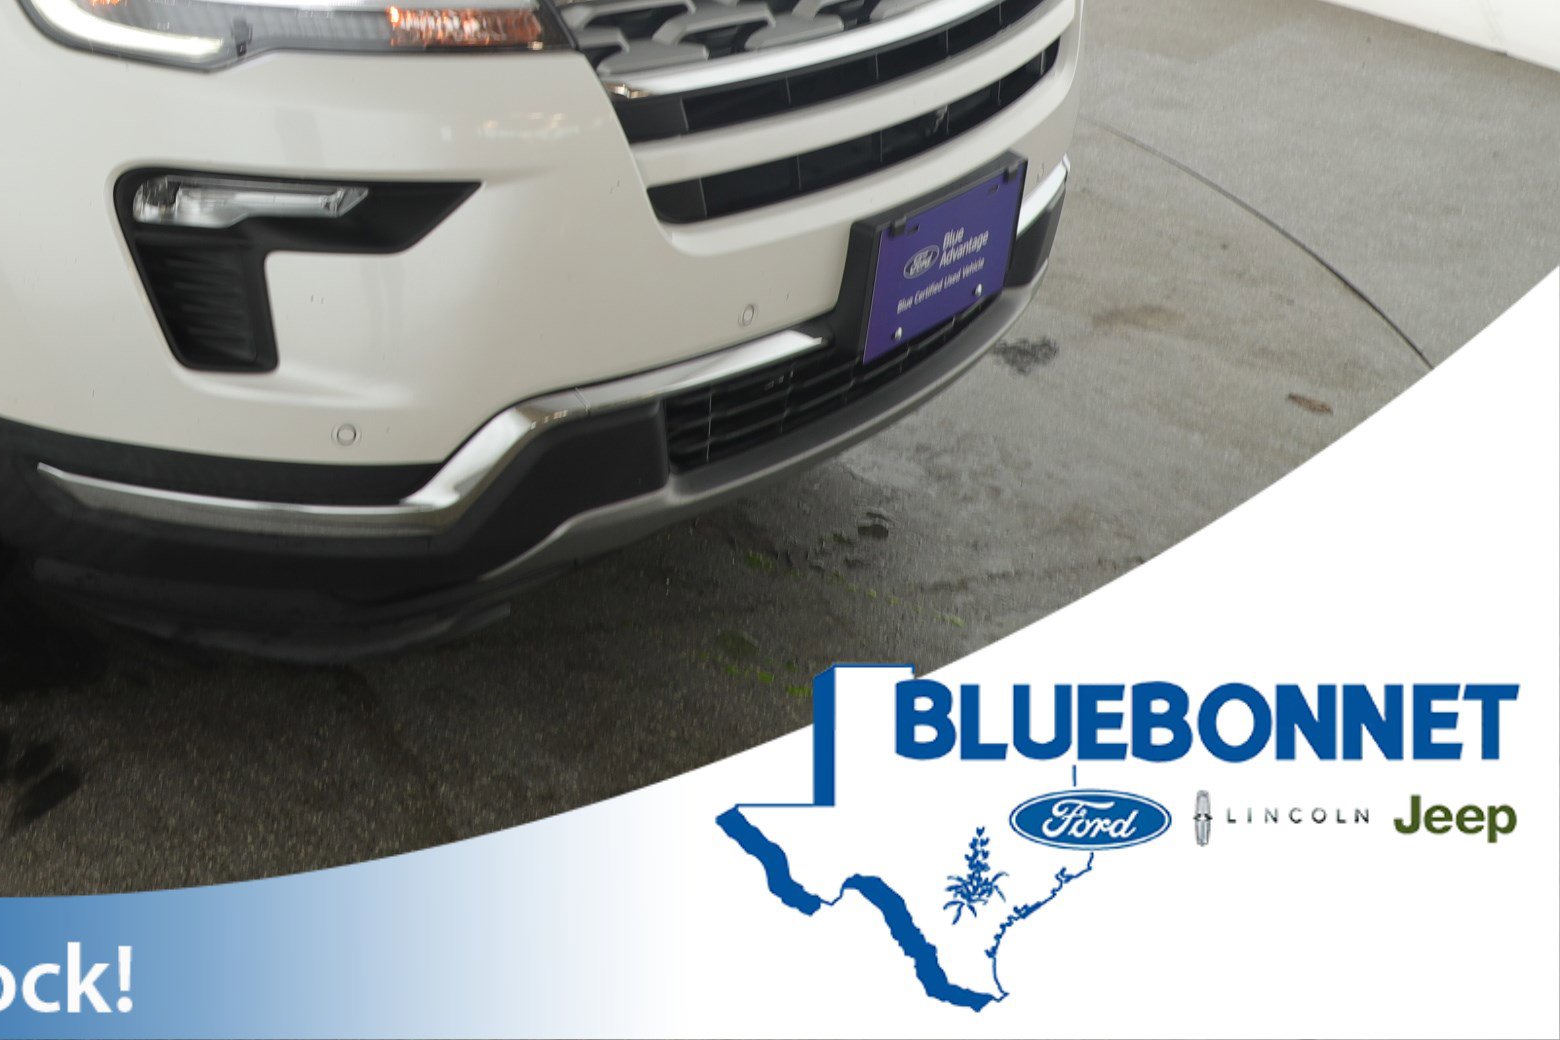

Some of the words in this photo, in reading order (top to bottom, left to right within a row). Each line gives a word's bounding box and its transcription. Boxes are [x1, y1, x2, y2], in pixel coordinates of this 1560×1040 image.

[938, 230, 989, 270] Advantage
[942, 226, 965, 252] Blue
[896, 295, 914, 315] Blue
[914, 277, 944, 306] Certified
[943, 266, 963, 290] Used
[962, 256, 986, 280] Vehicle
